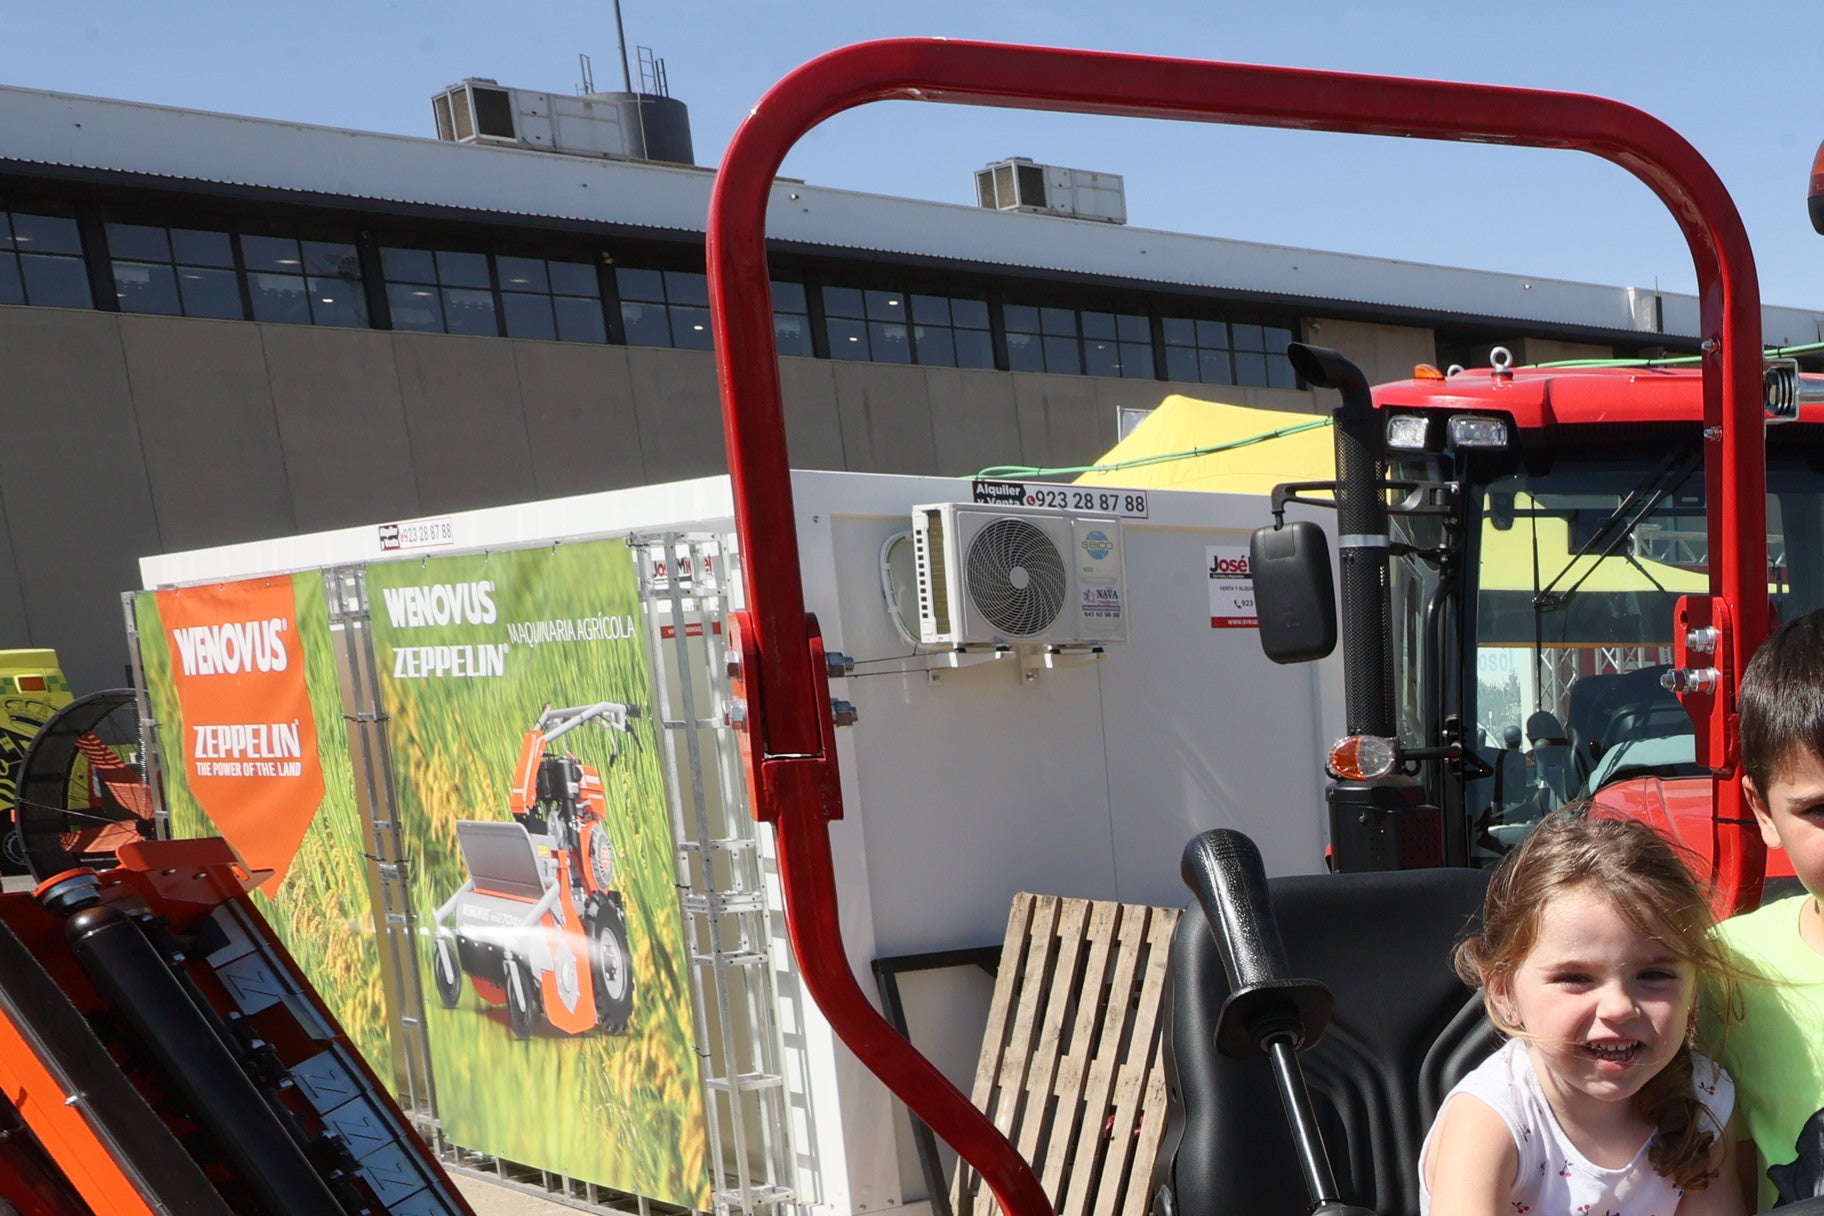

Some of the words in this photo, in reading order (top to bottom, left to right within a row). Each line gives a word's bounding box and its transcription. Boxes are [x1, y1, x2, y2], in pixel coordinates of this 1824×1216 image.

[975, 483, 1021, 497] Alquiler
[1035, 490, 1068, 508] 923
[1073, 492, 1094, 510] 28
[1099, 494, 1119, 511] 87
[1125, 495, 1146, 513] 88
[1209, 555, 1248, 573] José
[383, 580, 497, 628] WENOVUS
[1096, 588, 1119, 600] NAVA
[507, 619, 577, 648] MAQUINARIA
[577, 612, 636, 640] AGRÍCOLA
[173, 618, 288, 676] WENOVUS
[393, 643, 505, 679] ZEPPELIN
[192, 720, 301, 759] ZEPPELIN
[195, 762, 212, 776] THE
[213, 762, 242, 776] POWER
[243, 762, 254, 776] OF
[255, 762, 275, 777] THE
[276, 762, 301, 777] LAND
